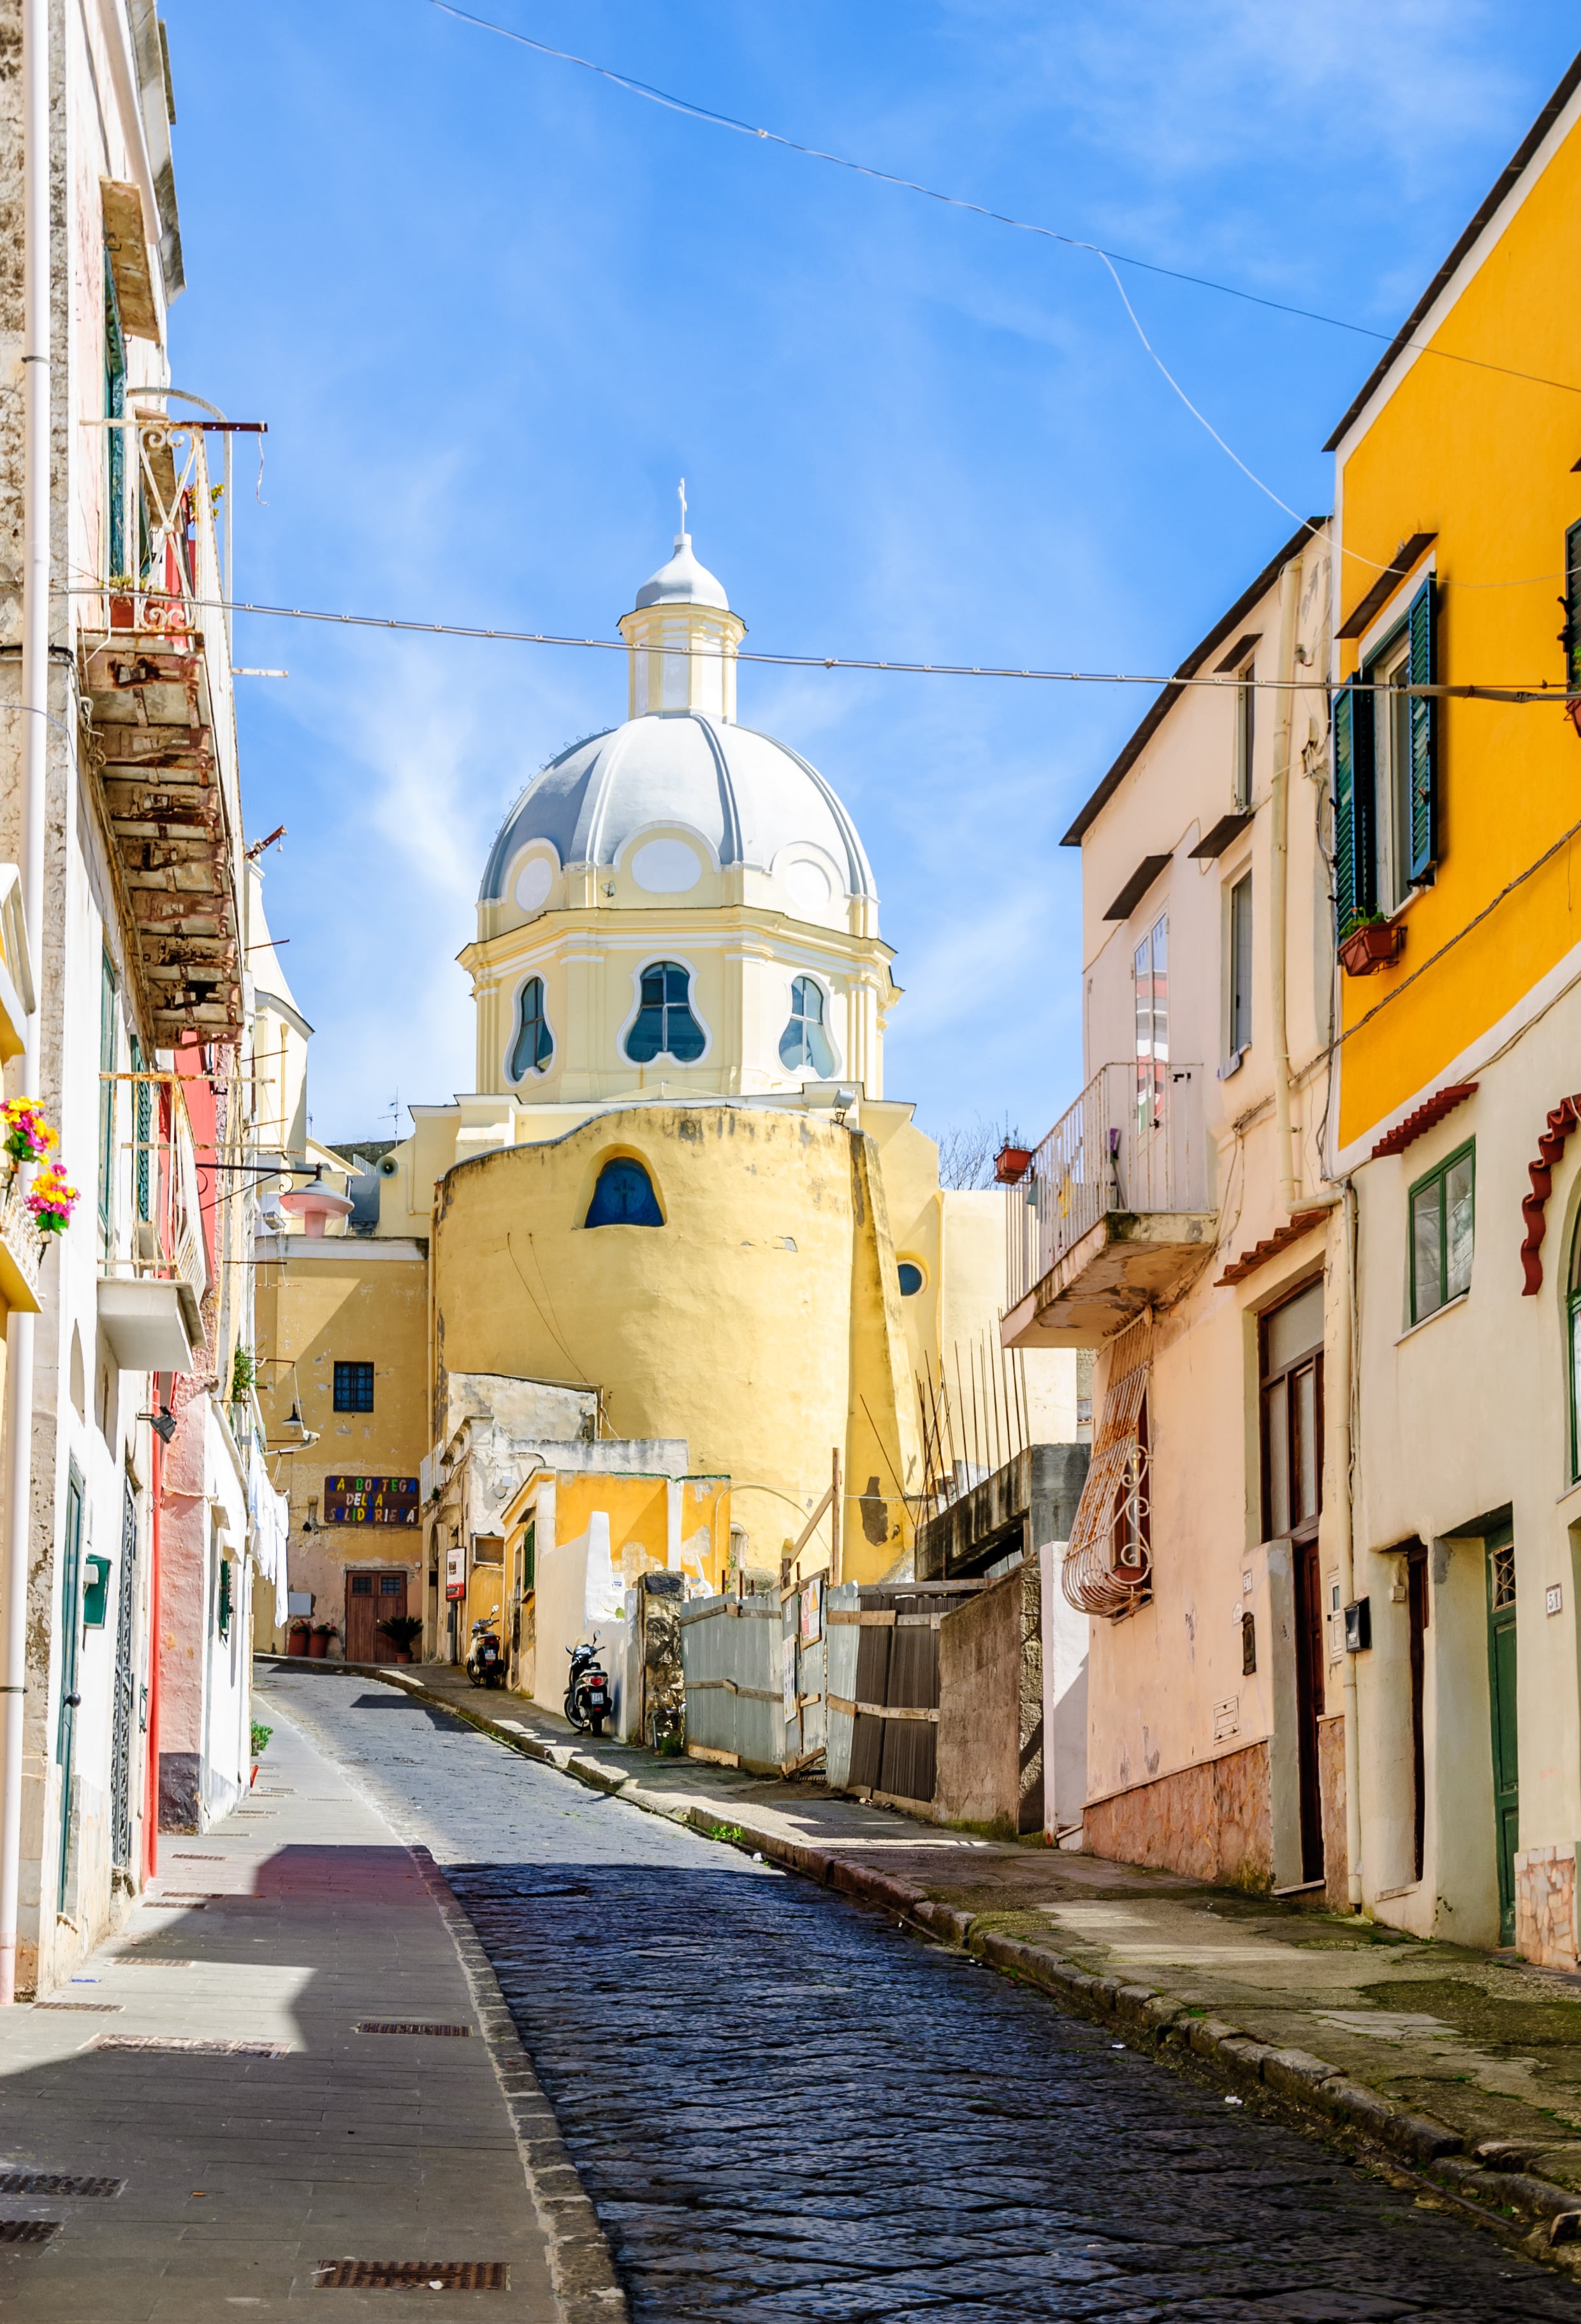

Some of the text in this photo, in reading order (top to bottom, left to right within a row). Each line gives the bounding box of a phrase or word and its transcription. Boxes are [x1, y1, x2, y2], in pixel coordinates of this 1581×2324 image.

[330, 1477, 416, 1493] LA BOTTEGA
[346, 1493, 382, 1507] DELLA
[1548, 1591, 1559, 1610] 51
